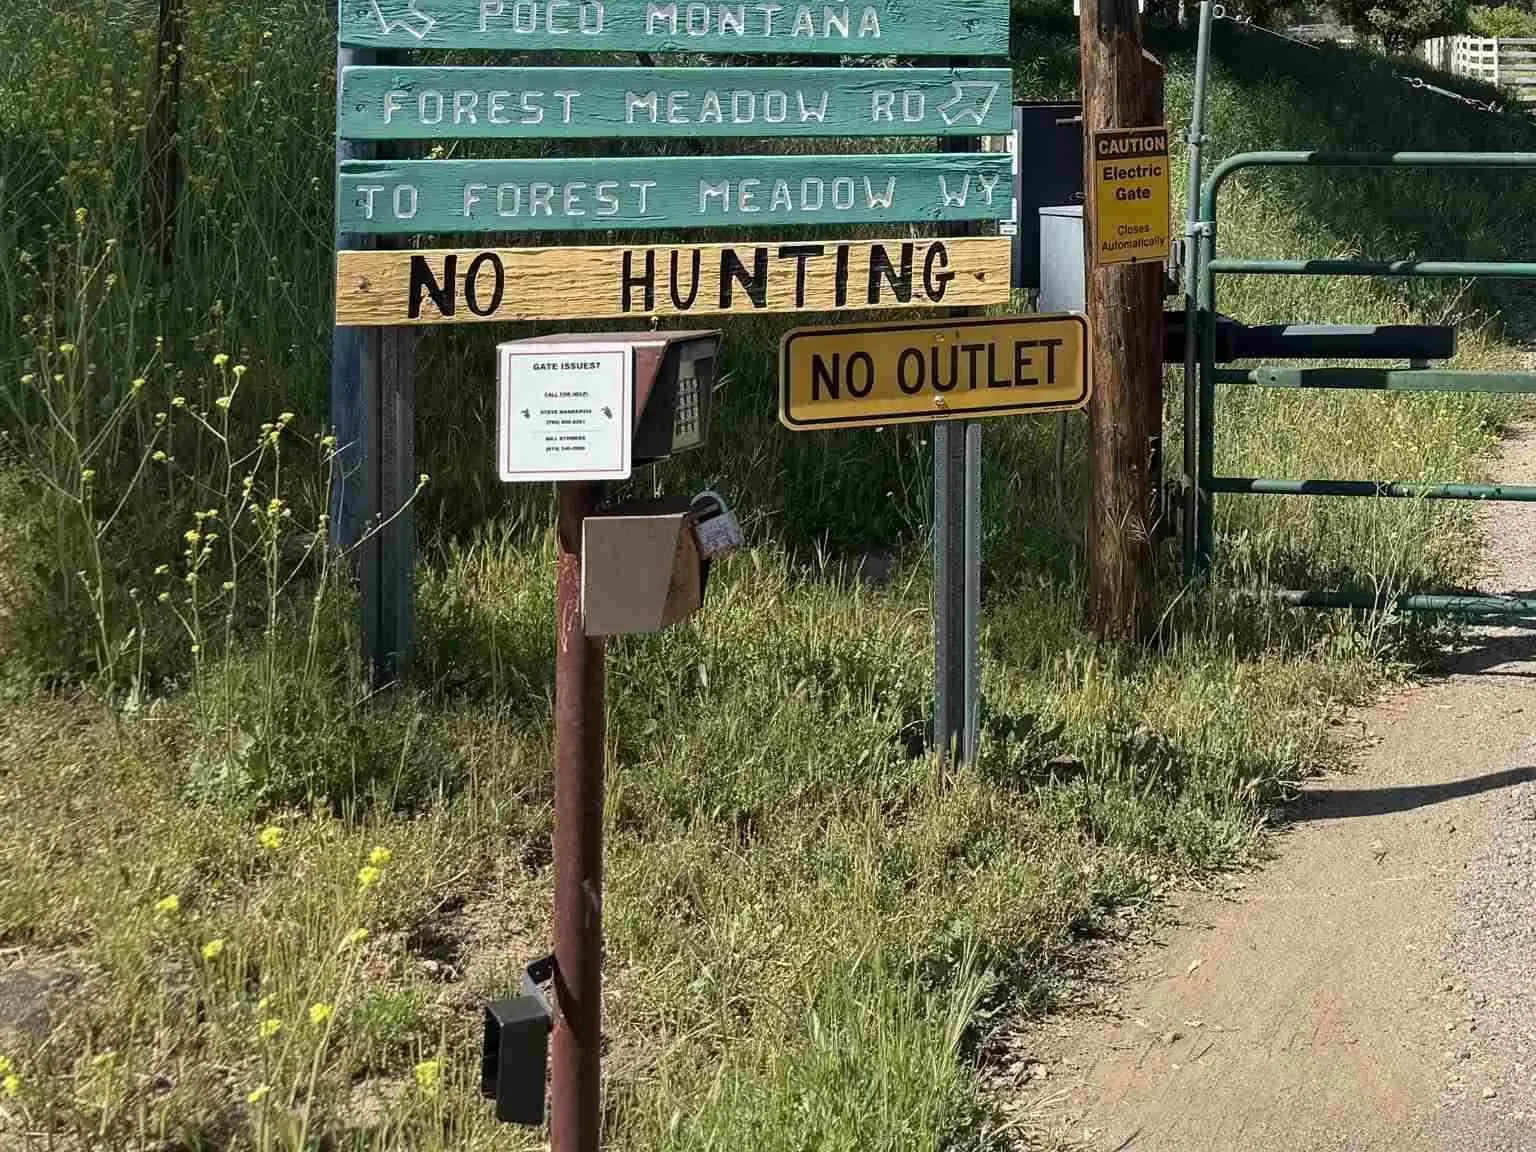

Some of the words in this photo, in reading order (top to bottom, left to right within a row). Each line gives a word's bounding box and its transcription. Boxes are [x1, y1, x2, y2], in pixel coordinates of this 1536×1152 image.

[383, 88, 582, 126] FOREST
[623, 88, 830, 126] MEADOW
[1098, 135, 1166, 155] CAUTION
[1103, 164, 1162, 181] Electric
[355, 183, 419, 220] TO
[462, 180, 658, 219] FOREST
[699, 175, 897, 213] MEADOW
[938, 173, 1001, 208] WY
[1115, 186, 1152, 202] Gate
[1117, 223, 1151, 237] Closes
[1102, 237, 1166, 251] Automatically
[407, 251, 505, 319] NO
[621, 240, 955, 313] HUNTING
[533, 362, 558, 370] GATE
[811, 351, 875, 401] NO
[897, 338, 1063, 395] OUTLET
